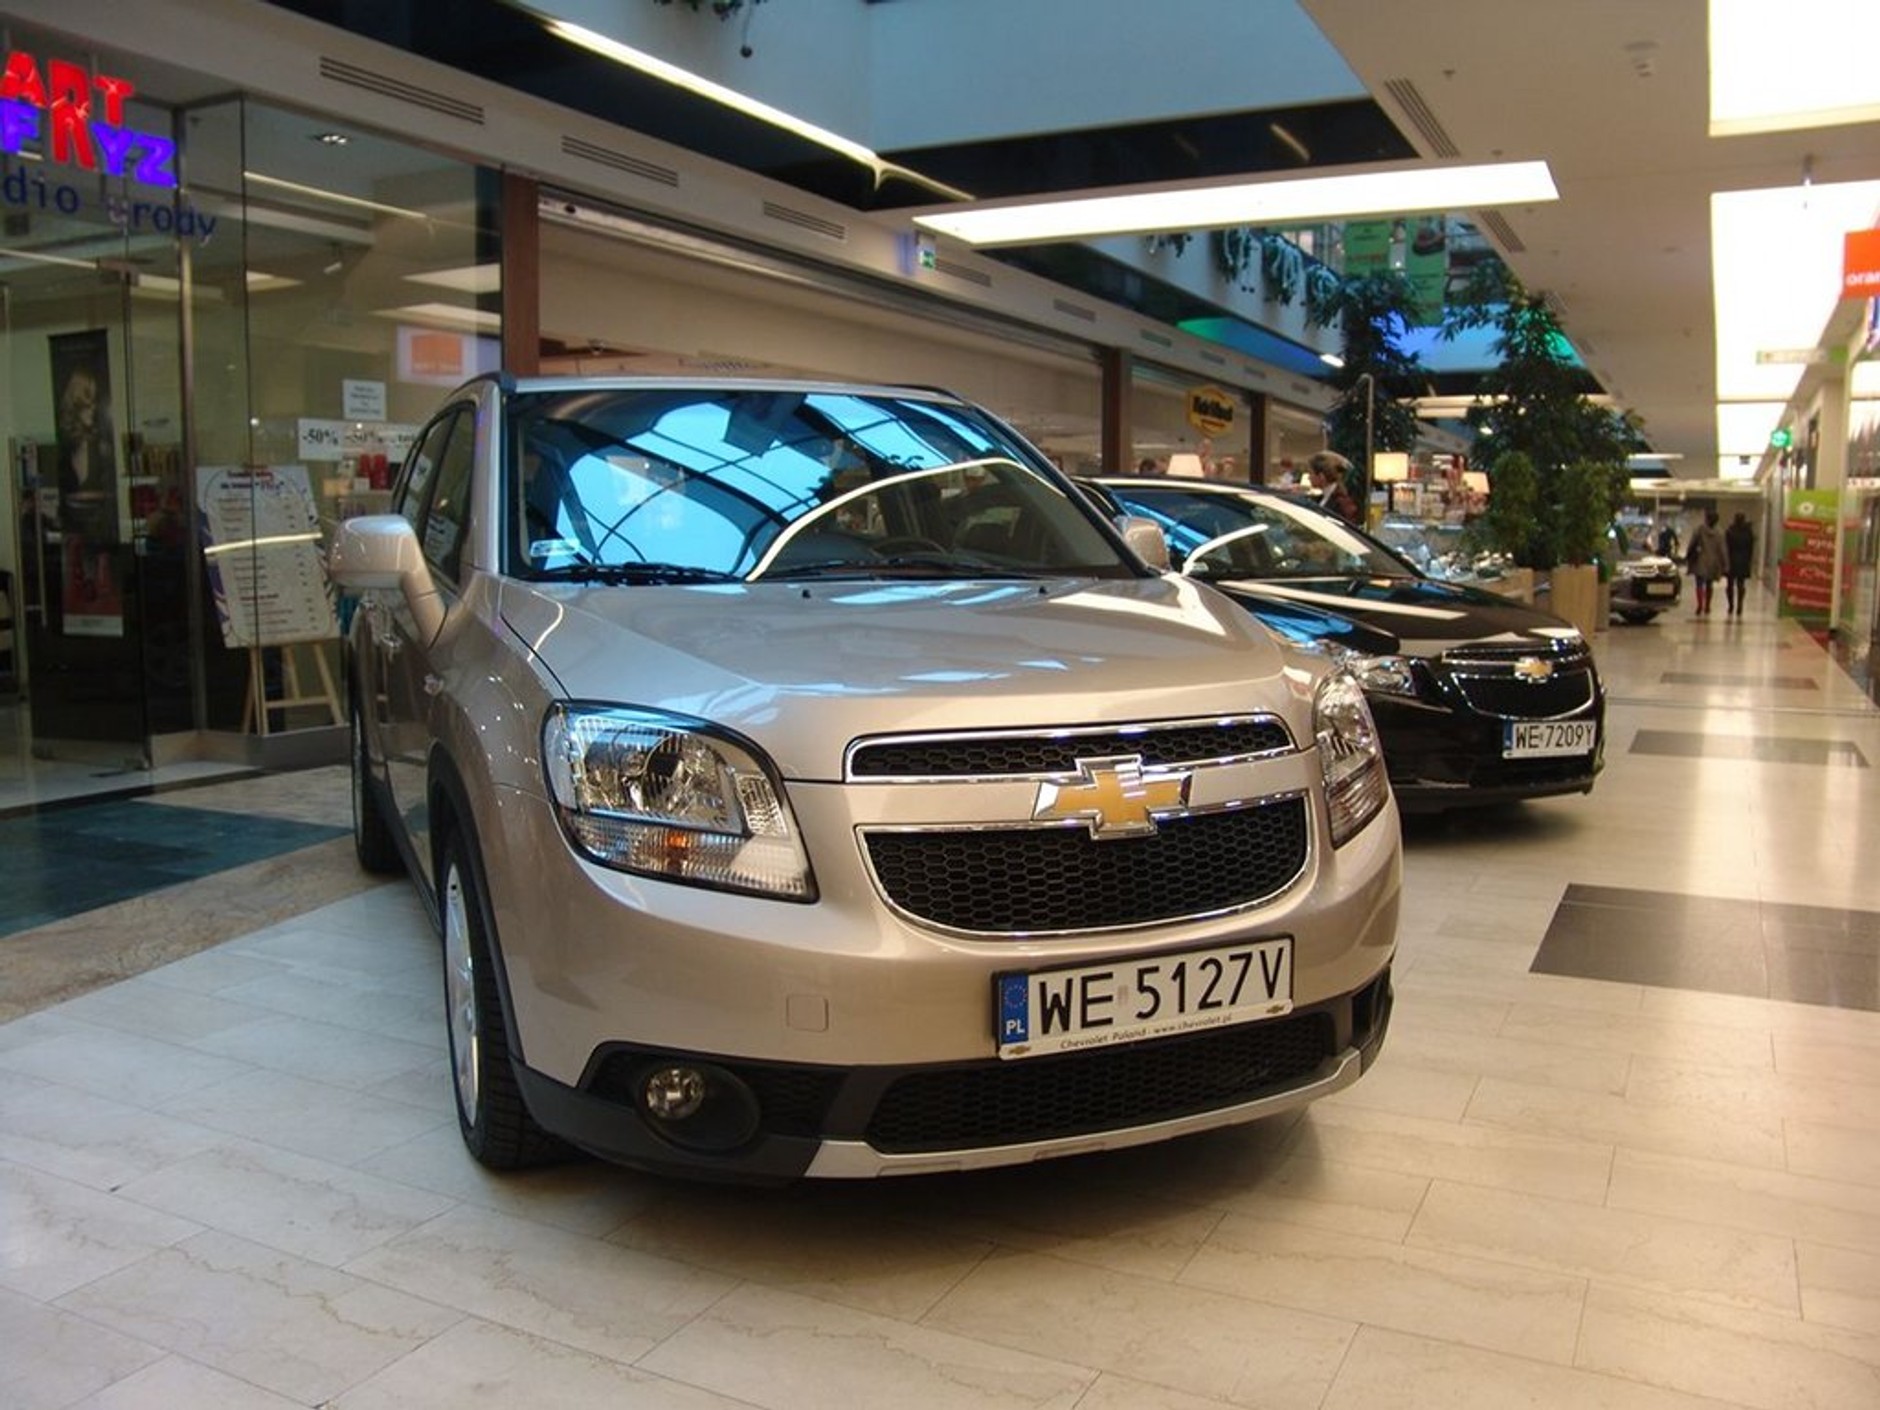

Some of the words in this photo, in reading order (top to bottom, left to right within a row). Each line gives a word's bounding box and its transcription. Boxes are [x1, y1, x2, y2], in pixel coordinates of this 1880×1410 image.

[0, 51, 134, 170] ART
[302, 427, 339, 446] -50%
[1516, 725, 1540, 749] WE
[1545, 724, 1594, 748] 7209Y
[1039, 971, 1113, 1035] WE
[1135, 946, 1284, 1020] 5127V
[1005, 1018, 1026, 1036] PL
